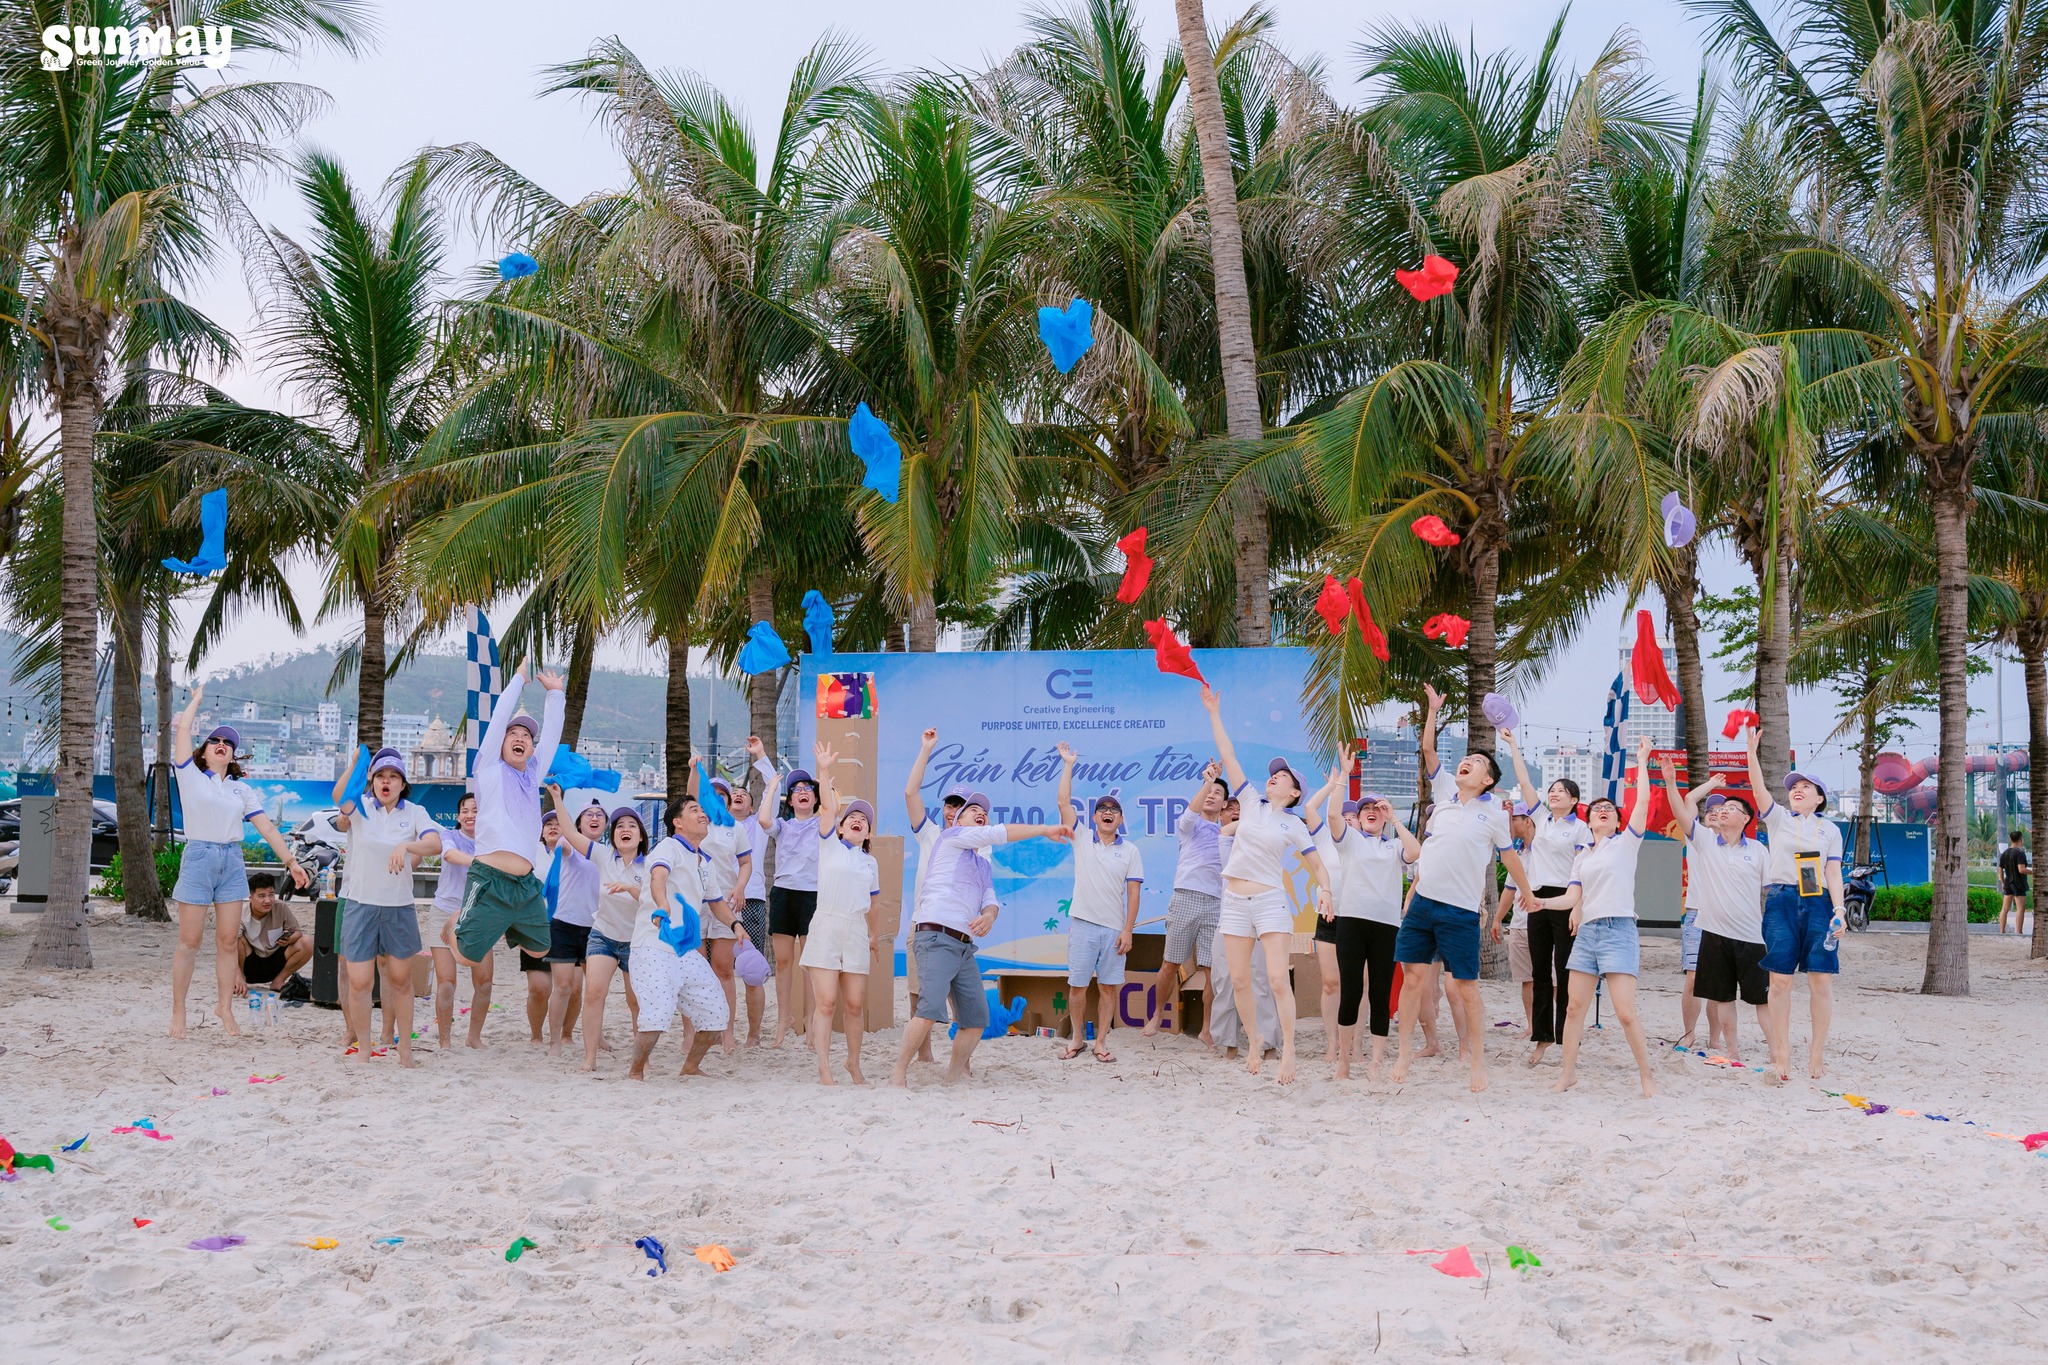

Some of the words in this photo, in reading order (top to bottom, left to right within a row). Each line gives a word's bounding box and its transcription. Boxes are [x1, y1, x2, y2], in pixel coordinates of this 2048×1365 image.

[1046, 669, 1093, 700] CE
[1023, 705, 1061, 714] Creative
[1063, 704, 1115, 715] Engineering
[981, 721, 1023, 731] PURPOSE
[1025, 720, 1061, 730] UNITED,
[1063, 720, 1122, 730] EXCELLENCE
[1124, 719, 1166, 729] CREATED
[920, 743, 1006, 798] Gắn
[1011, 746, 1072, 788] kết
[1071, 762, 1143, 789] mục
